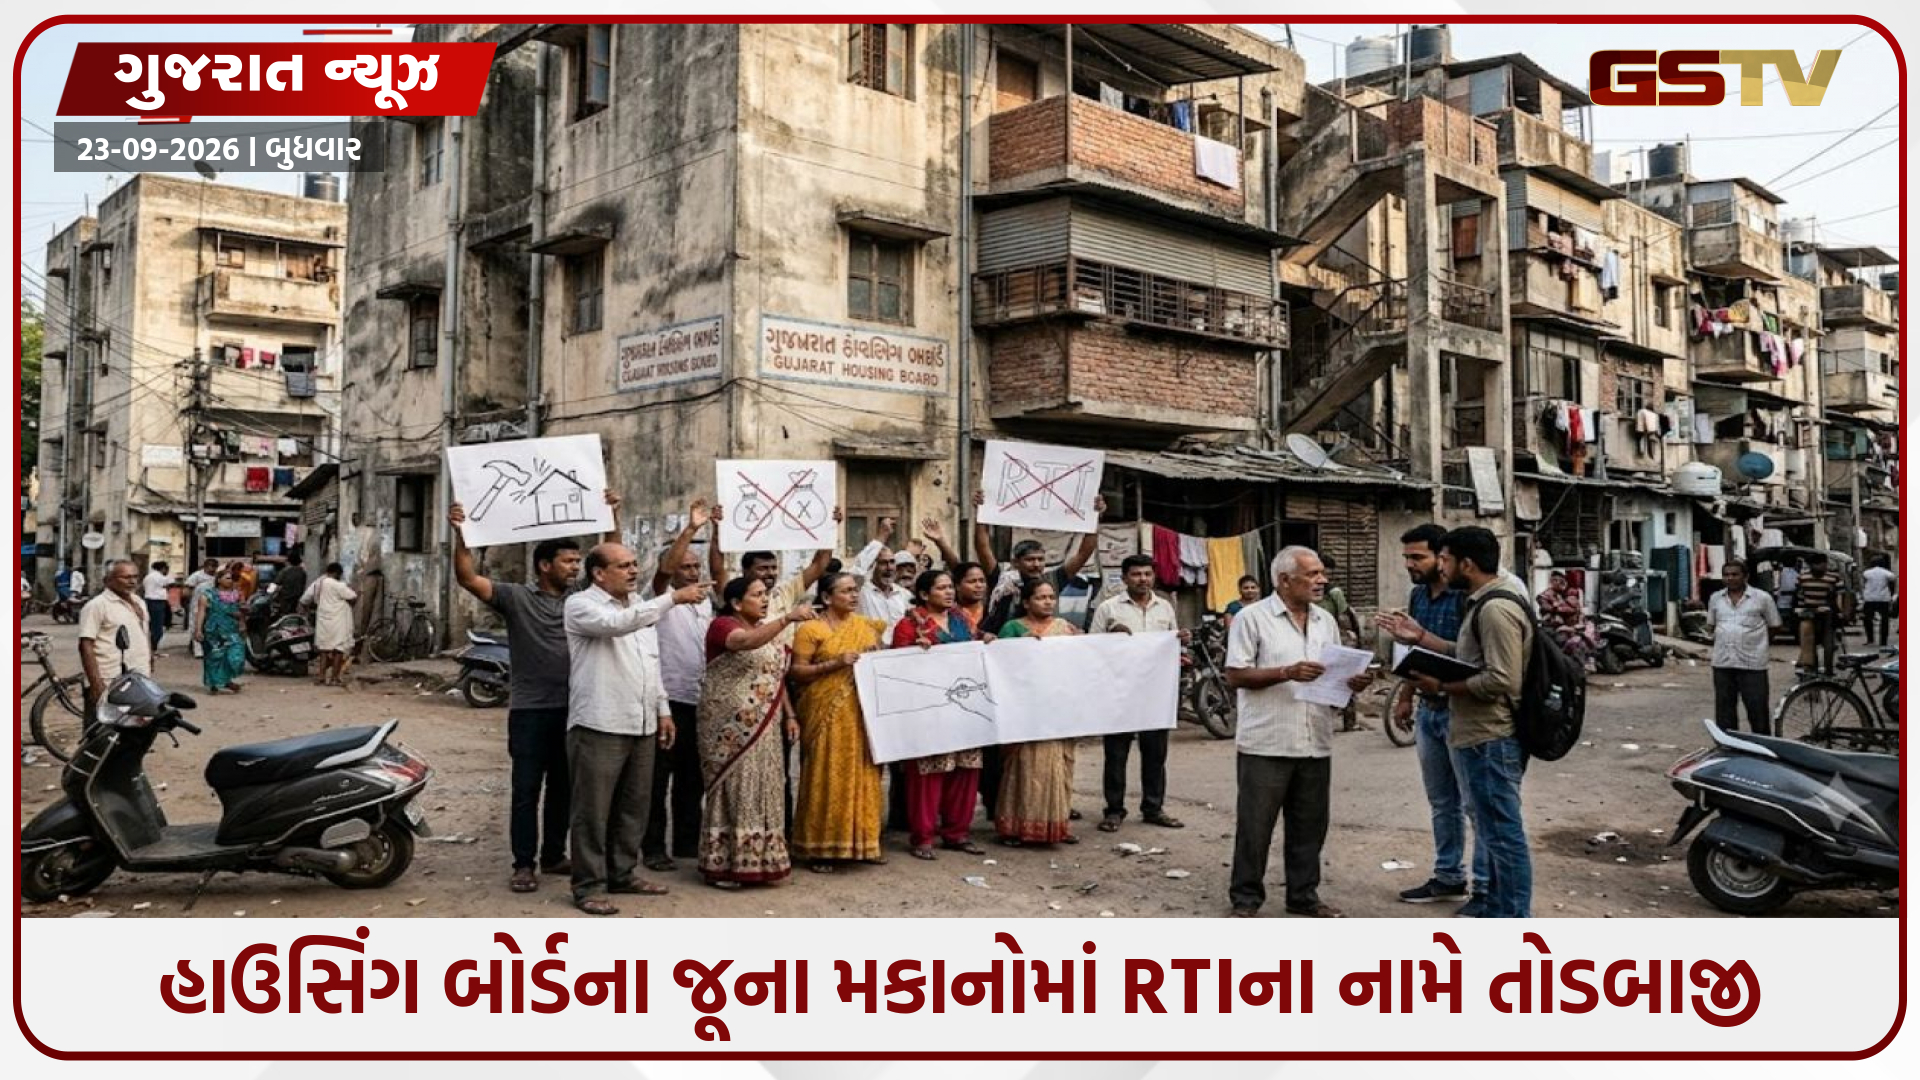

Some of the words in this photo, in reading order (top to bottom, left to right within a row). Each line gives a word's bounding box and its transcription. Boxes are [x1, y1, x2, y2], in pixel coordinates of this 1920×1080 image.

[773, 354, 835, 375] GUJARAT
[843, 363, 894, 382] HOUSING
[997, 458, 1095, 516] RTI
